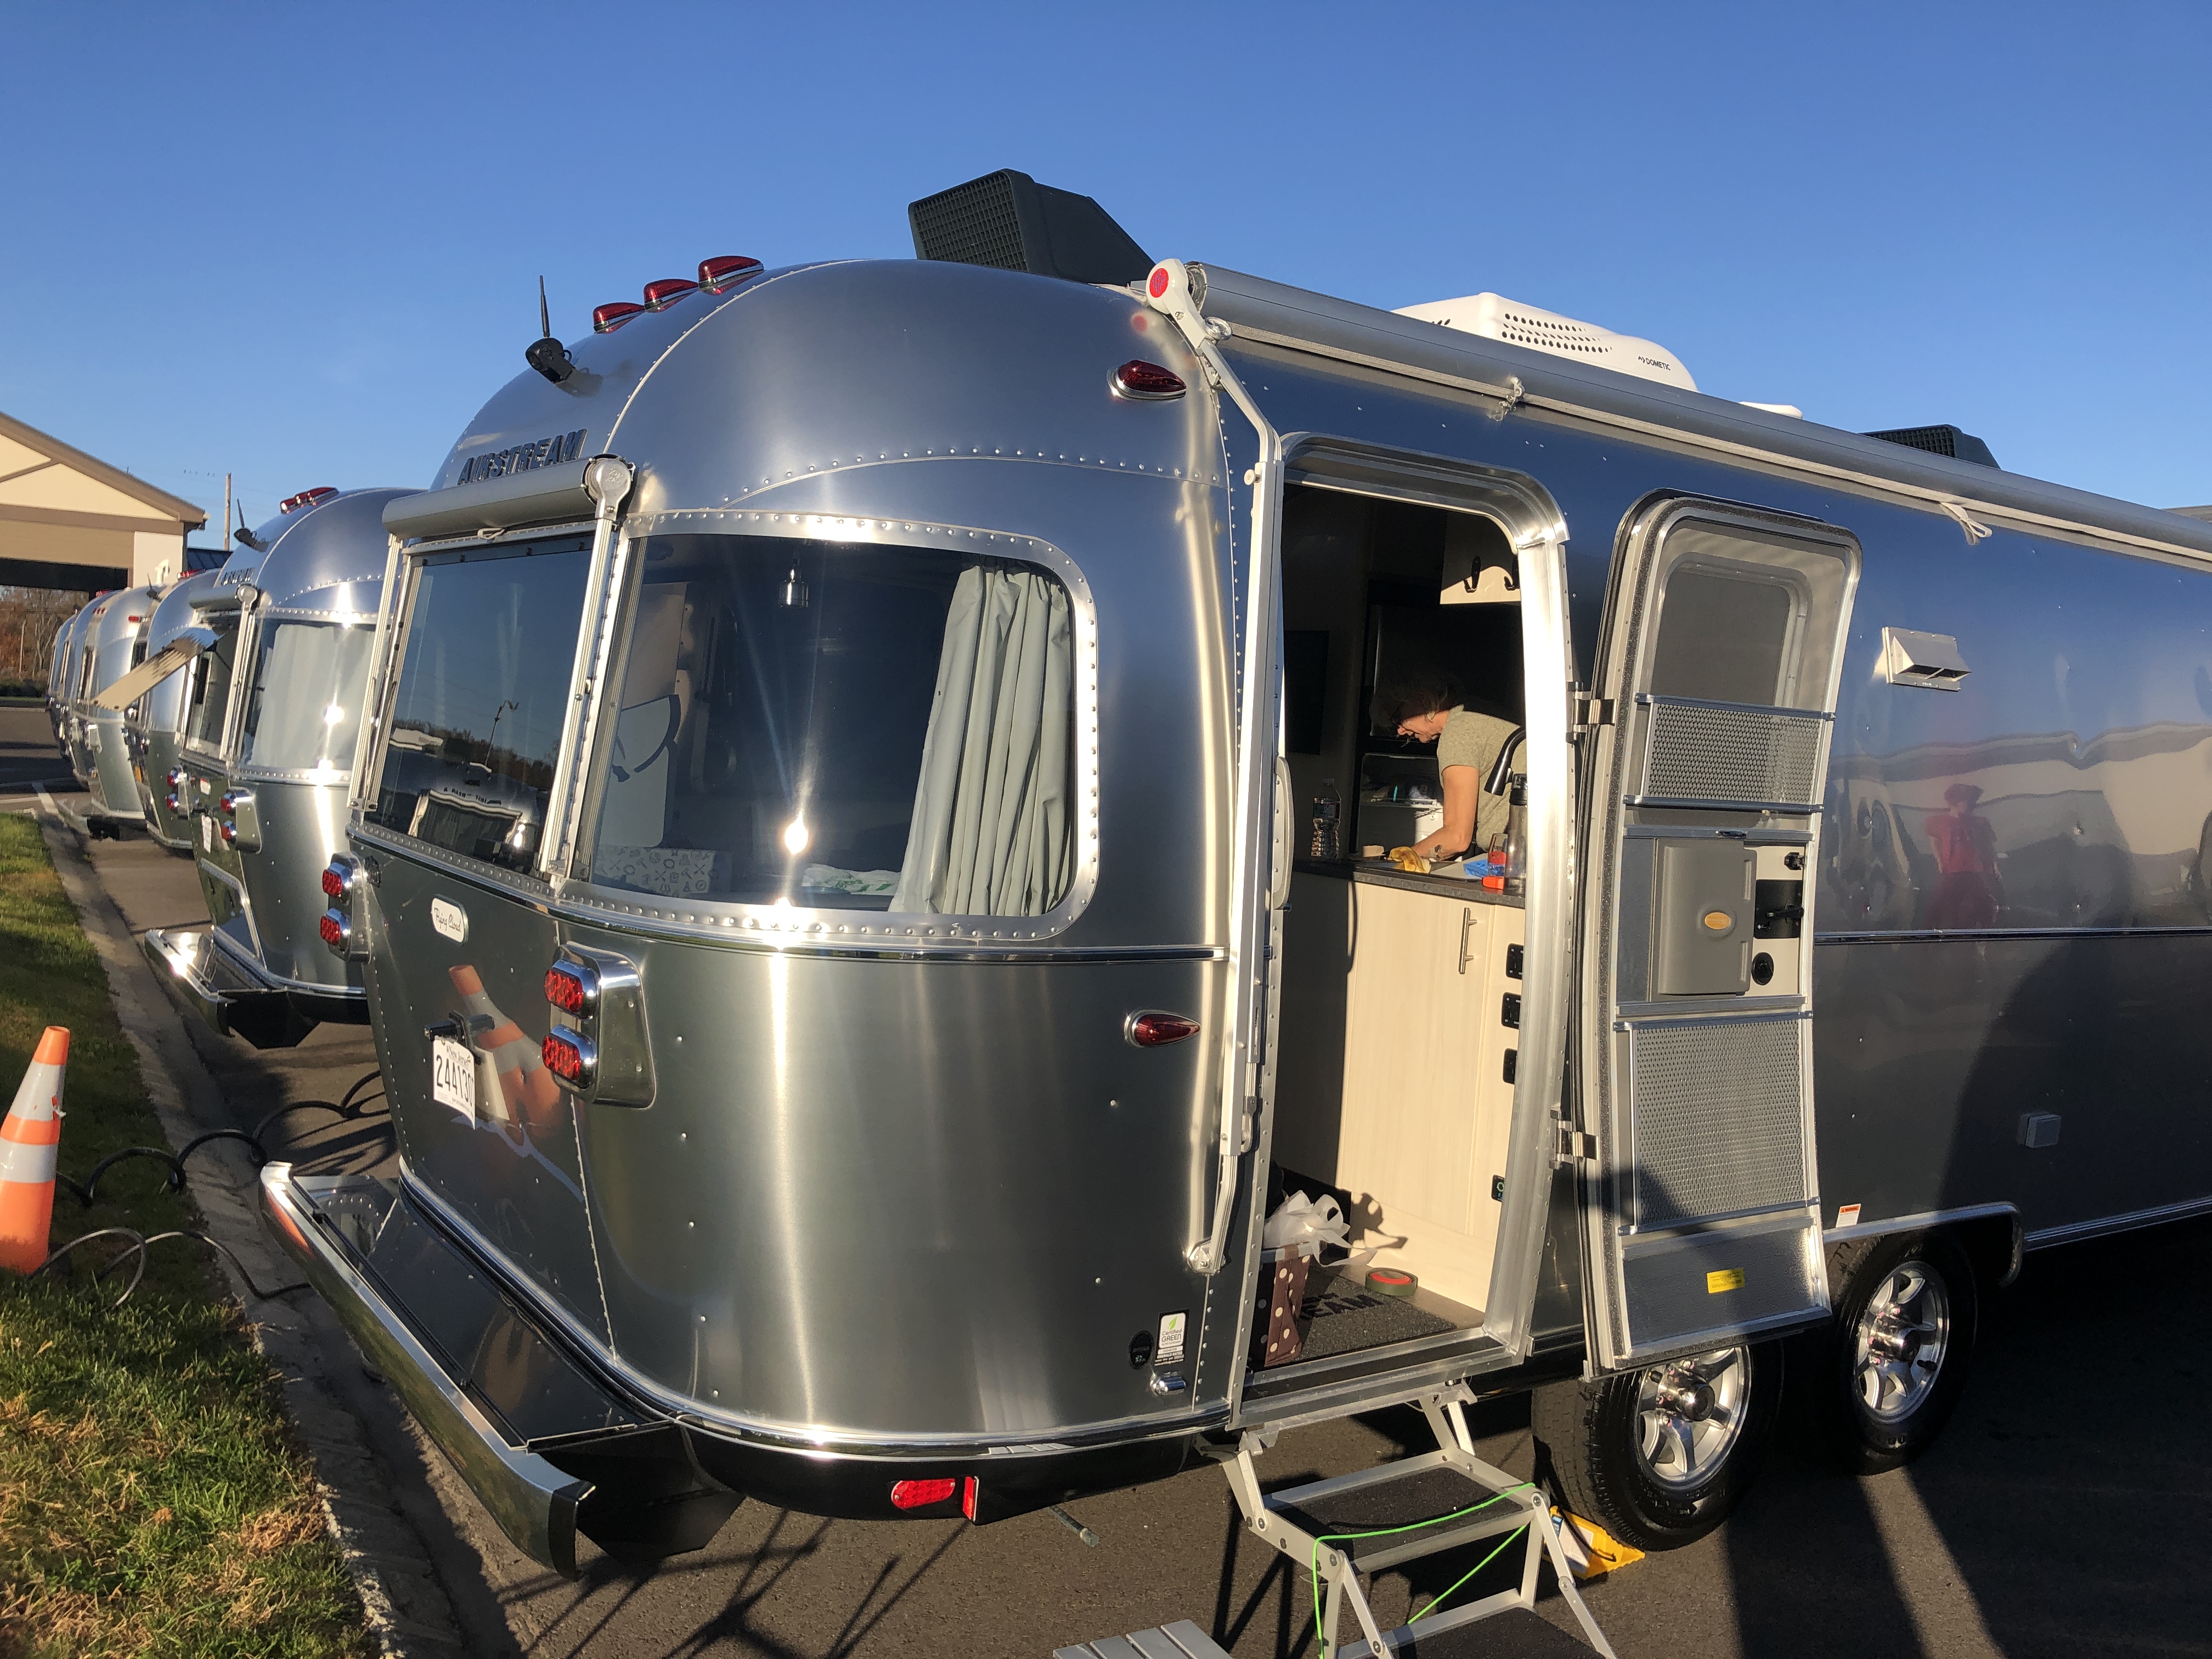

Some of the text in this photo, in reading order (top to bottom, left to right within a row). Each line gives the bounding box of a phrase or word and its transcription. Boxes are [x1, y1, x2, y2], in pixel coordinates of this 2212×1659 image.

[1646, 358, 1671, 371] DOMETIC
[457, 428, 587, 486] AIRSTREAM
[434, 907, 461, 932] Flying Cloud
[449, 1045, 457, 1058] New
[1161, 1333, 1182, 1342] GREEN
